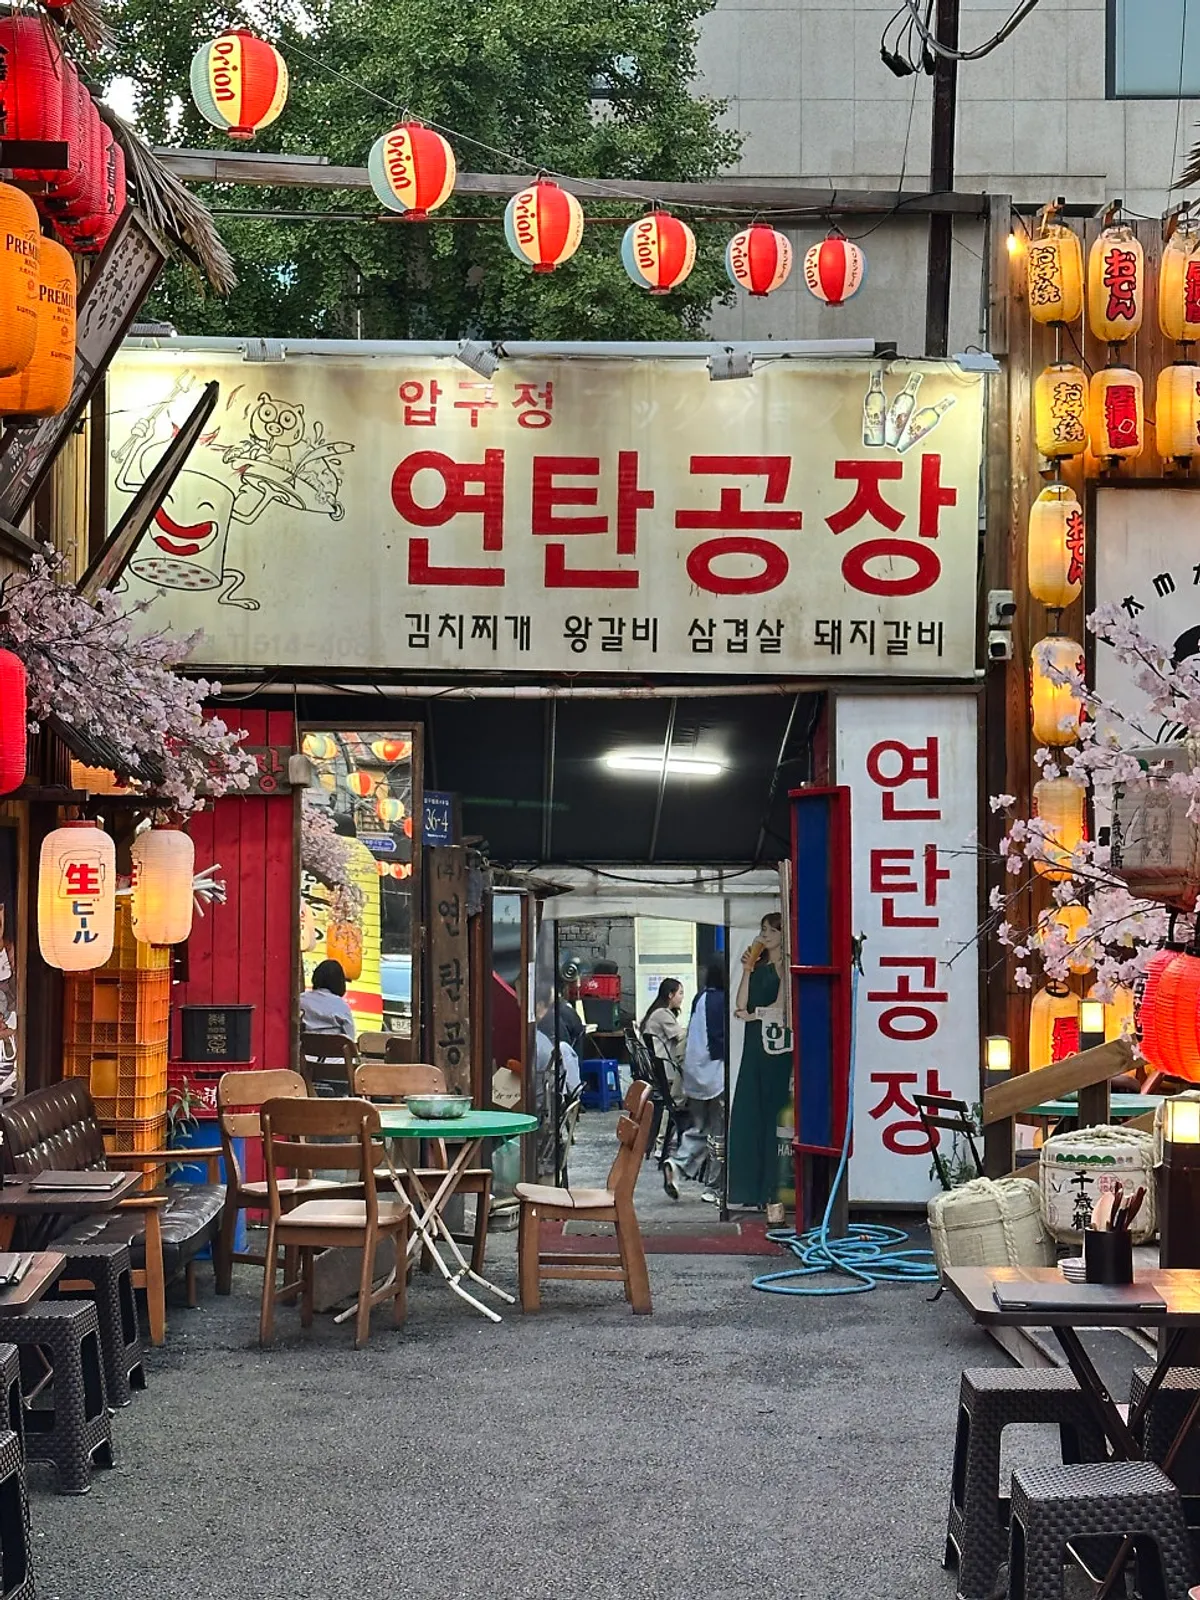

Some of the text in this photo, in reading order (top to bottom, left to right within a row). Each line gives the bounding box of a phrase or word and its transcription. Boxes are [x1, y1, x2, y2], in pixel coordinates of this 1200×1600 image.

[213, 42, 239, 102] Orion
[387, 135, 413, 191] Orion
[515, 193, 535, 246] Orion
[637, 222, 657, 270] Orion
[734, 236, 748, 279] Orion
[806, 248, 819, 289] Orion
[1104, 248, 1137, 322] おでん
[399, 380, 554, 429] 압구정
[391, 448, 957, 597] 연탄공장
[405, 613, 944, 657] 김치찌개 왕갈비 삼겹살 돼지갈비
[425, 808, 449, 833] 36-4
[65, 863, 100, 944] 生ビール
[867, 736, 952, 1156] 연탄공장
